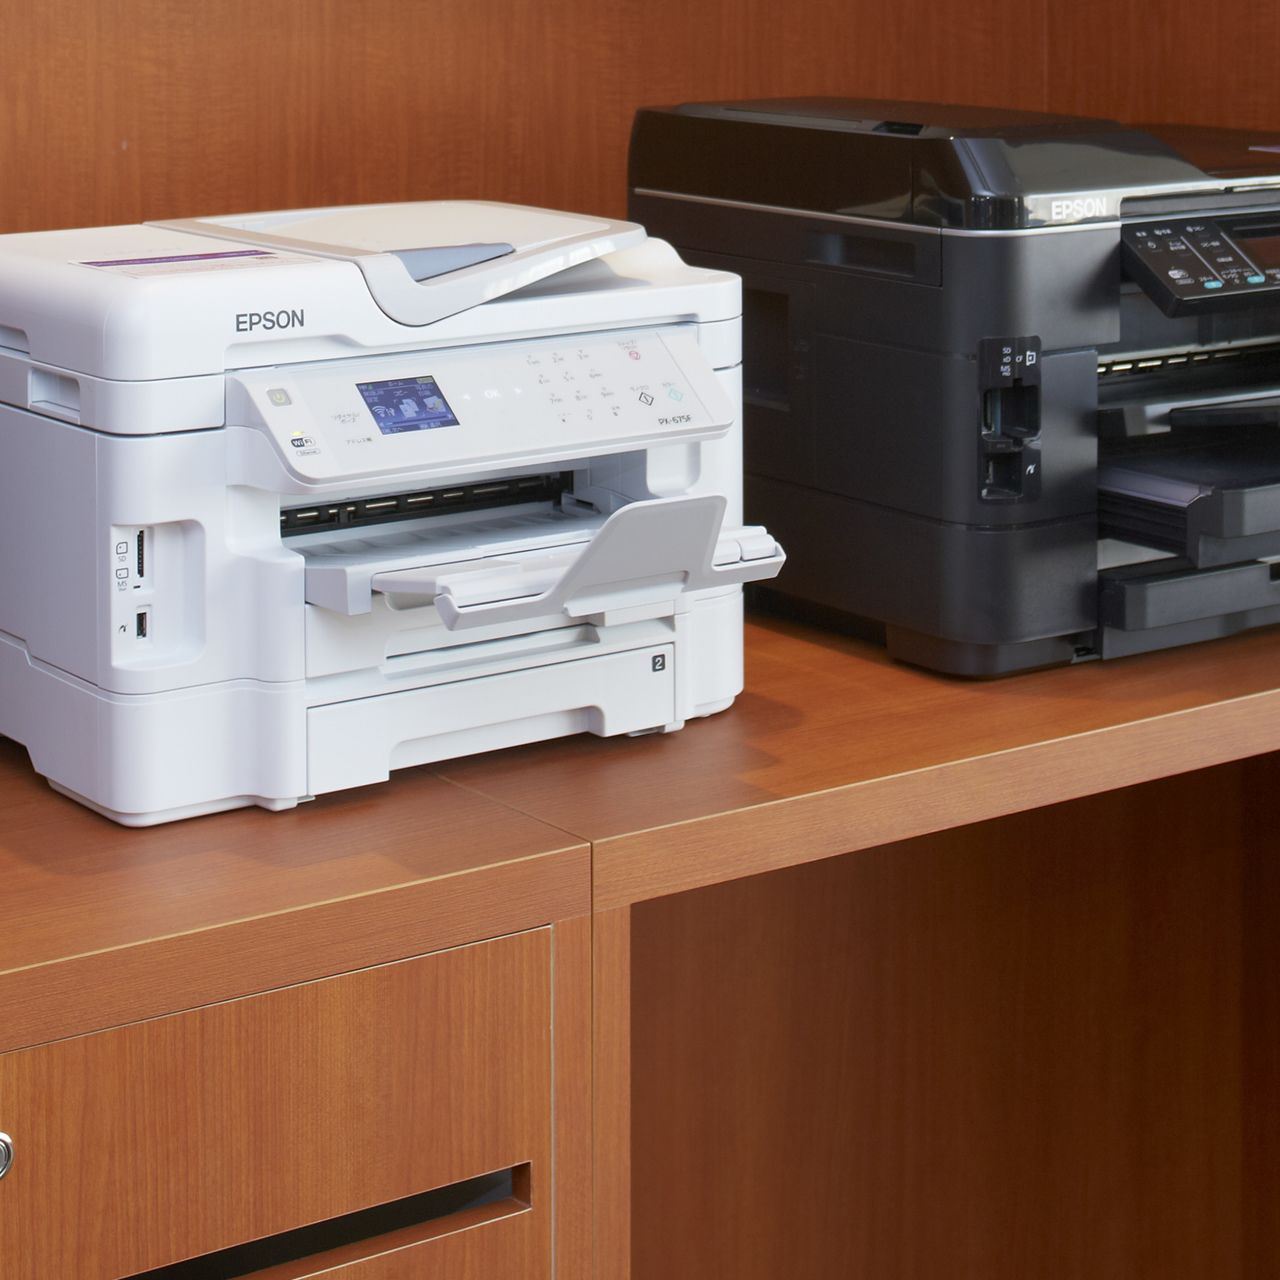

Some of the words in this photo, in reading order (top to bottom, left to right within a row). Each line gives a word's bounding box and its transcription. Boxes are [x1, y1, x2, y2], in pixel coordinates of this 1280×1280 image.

[1051, 198, 1107, 221] EPSON
[236, 309, 304, 332] EPSON
[655, 656, 663, 670] 2
